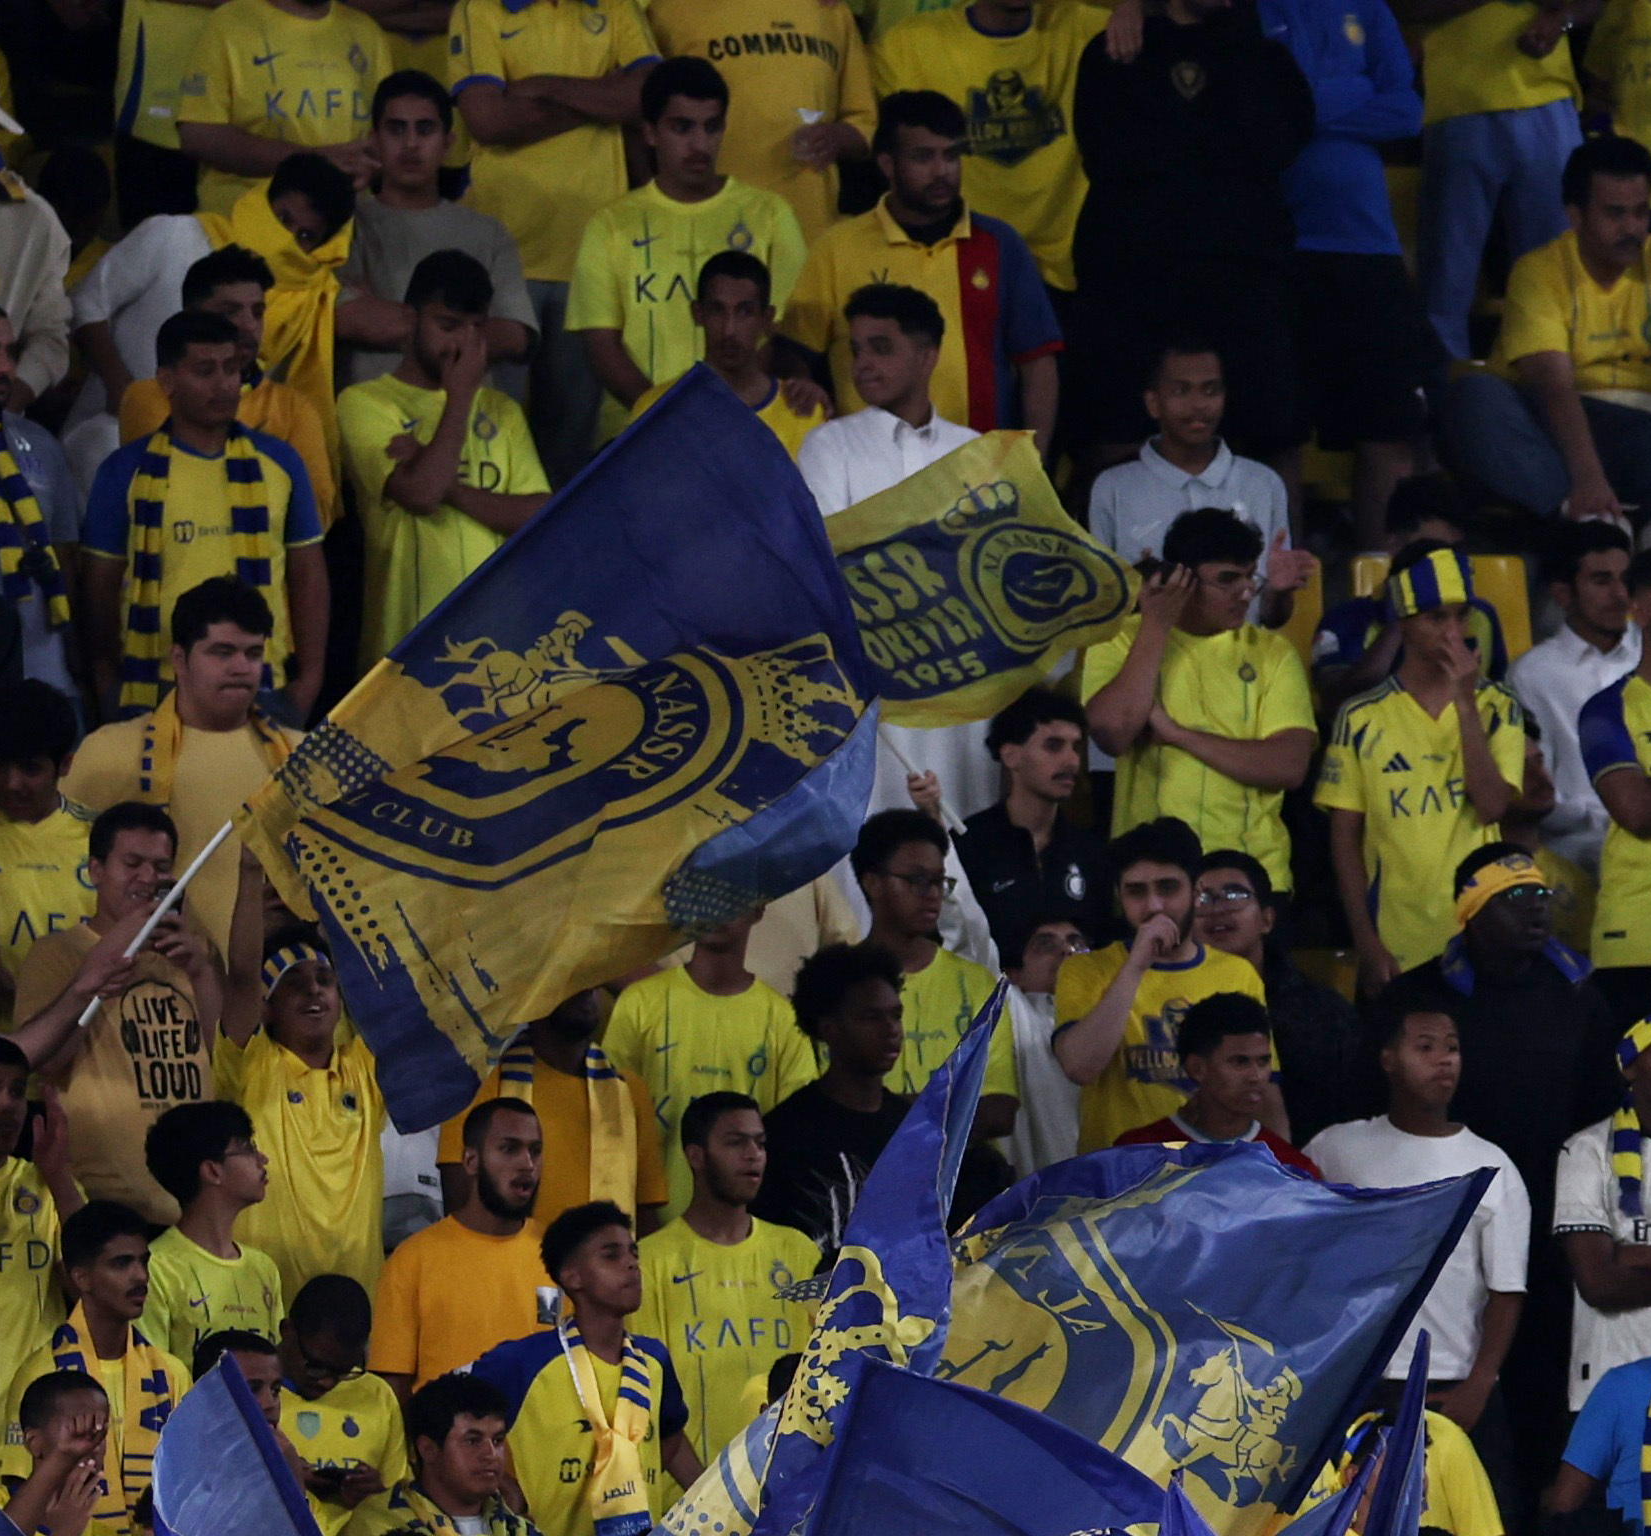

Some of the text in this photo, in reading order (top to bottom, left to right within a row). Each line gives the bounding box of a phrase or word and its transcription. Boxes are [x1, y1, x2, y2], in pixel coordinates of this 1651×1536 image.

[633, 274, 693, 303] KA
[840, 540, 947, 632] SSR
[851, 597, 982, 668] OREVER
[608, 669, 696, 782] NASSR
[1388, 783, 1463, 821] KAF
[371, 800, 475, 849] CLUB
[133, 995, 185, 1027] LIVE
[142, 1029, 185, 1062] LIFE
[134, 1061, 202, 1100] LOUD
[685, 1319, 791, 1354] KAFD
